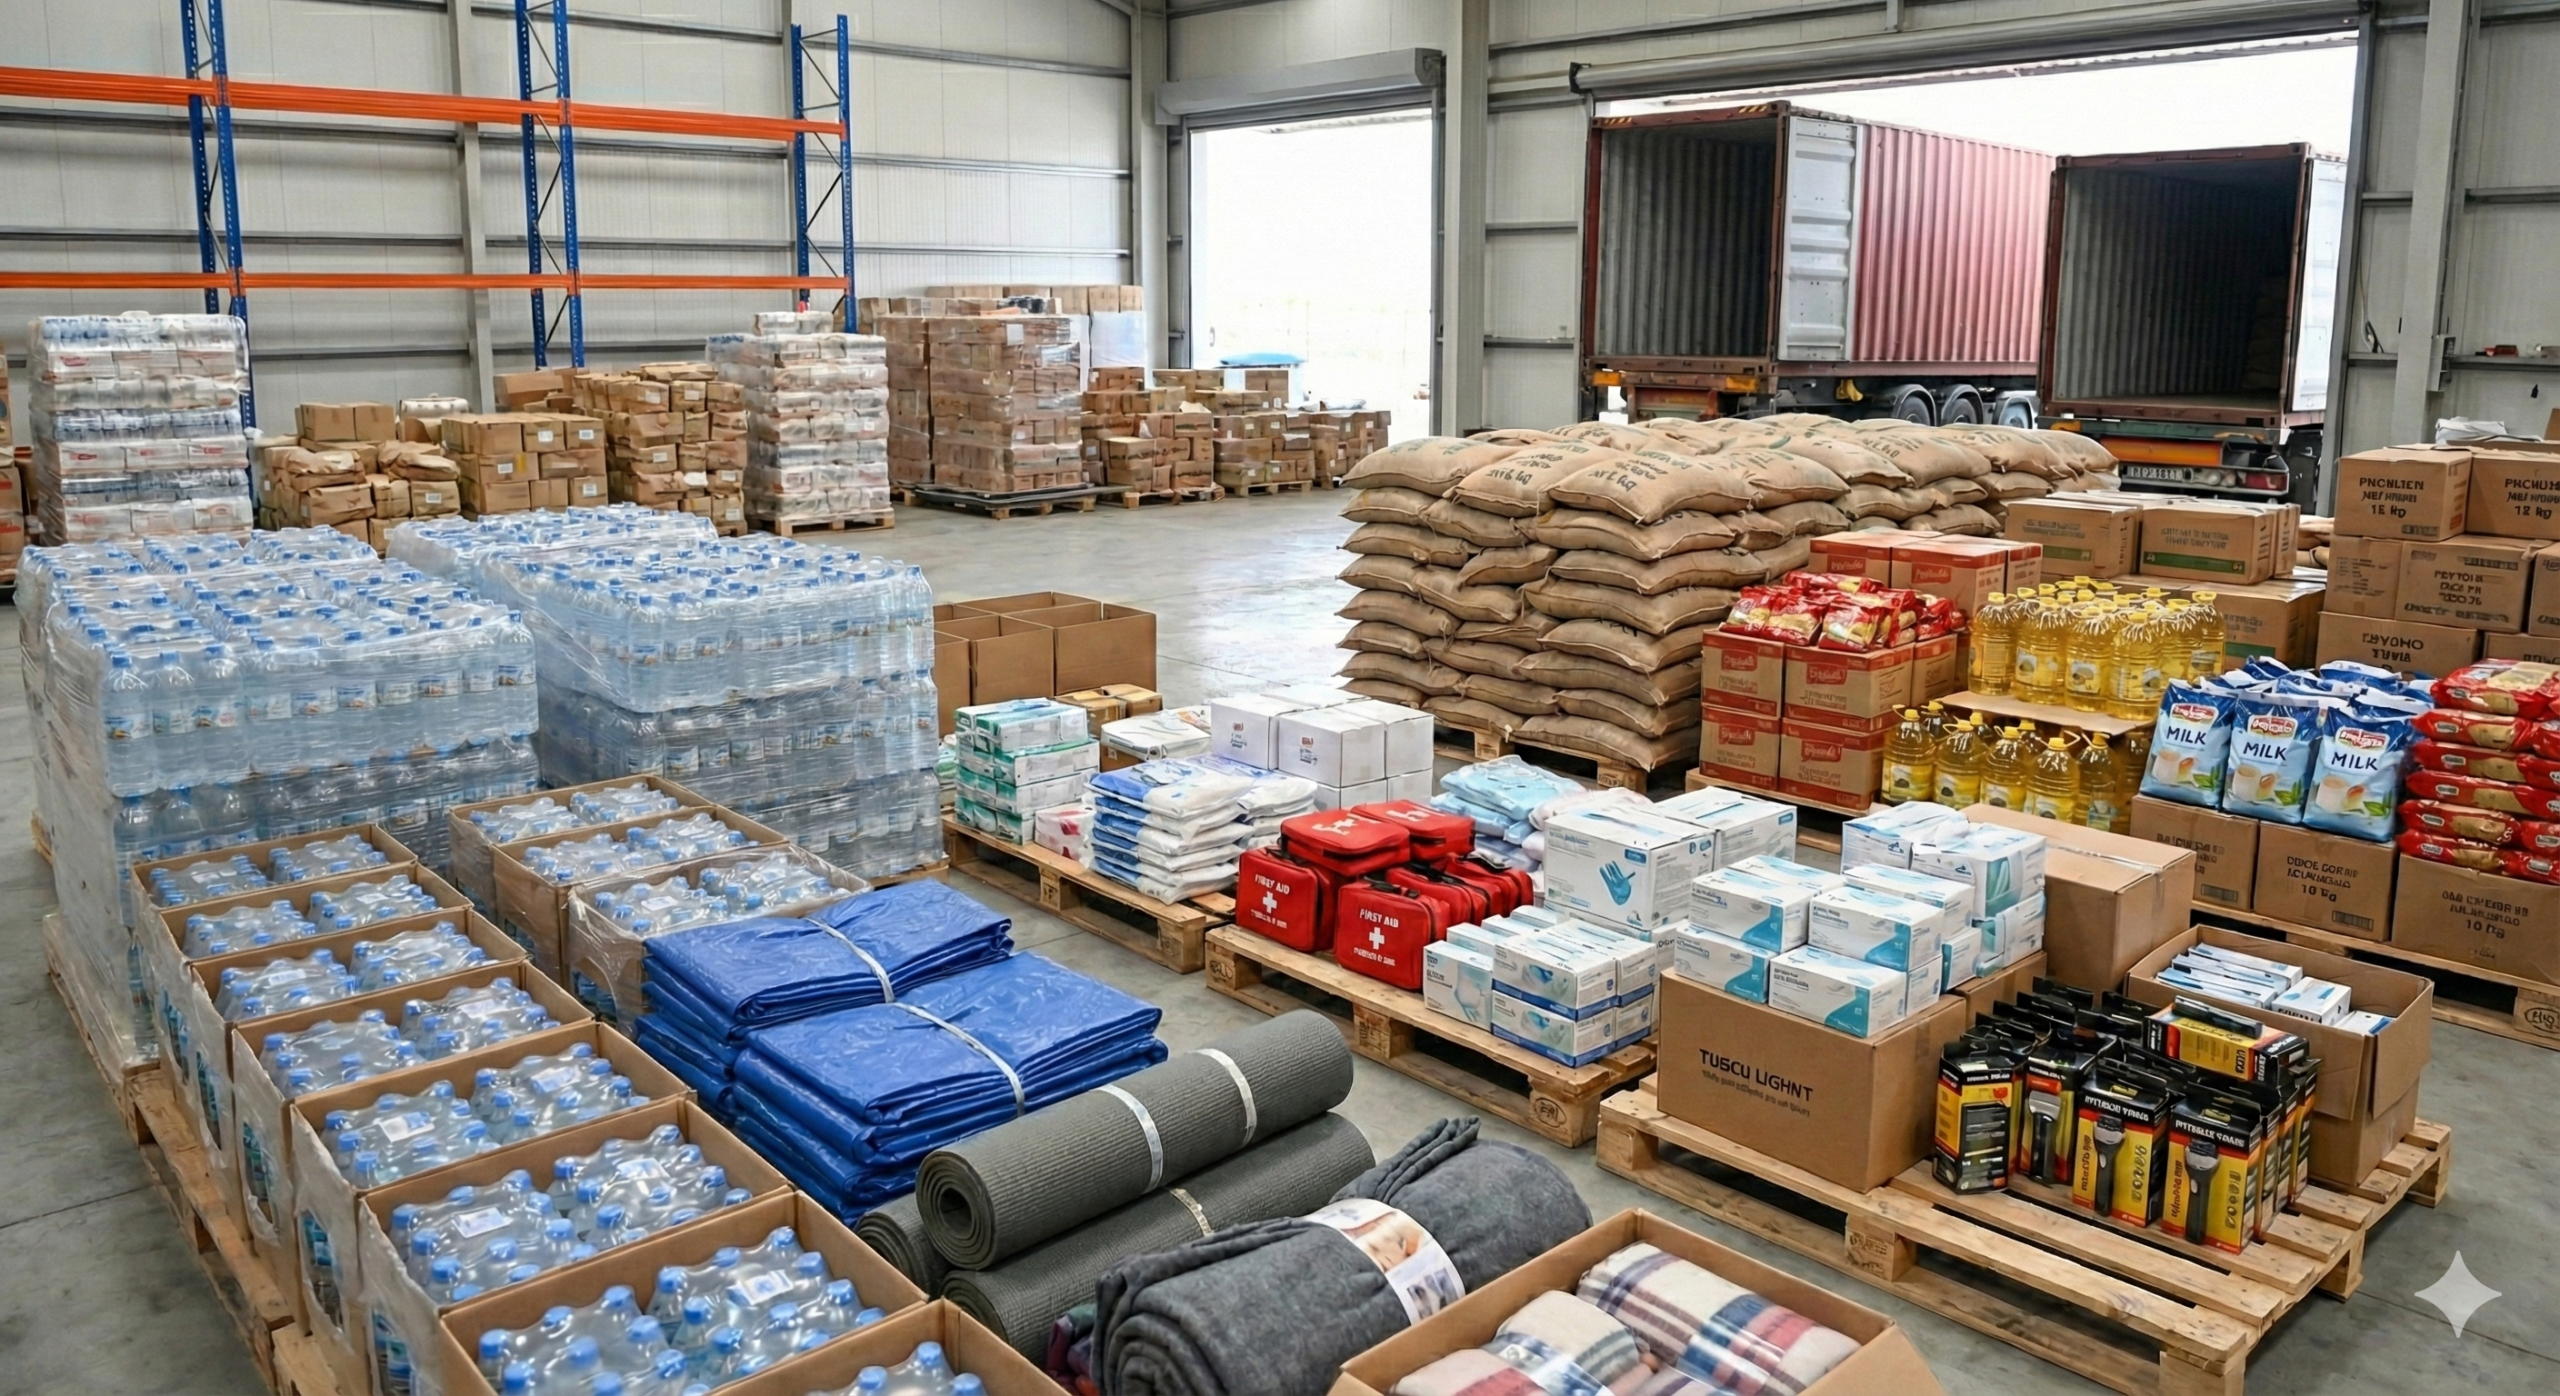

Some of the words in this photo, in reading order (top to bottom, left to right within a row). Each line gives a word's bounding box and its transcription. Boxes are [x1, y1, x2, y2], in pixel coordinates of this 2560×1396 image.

[2166, 726, 2206, 745] MILK
[2243, 741, 2287, 761] MILK
[2331, 752, 2378, 771] MILK
[1275, 881, 1290, 895] AID
[1384, 916, 1399, 928] AID
